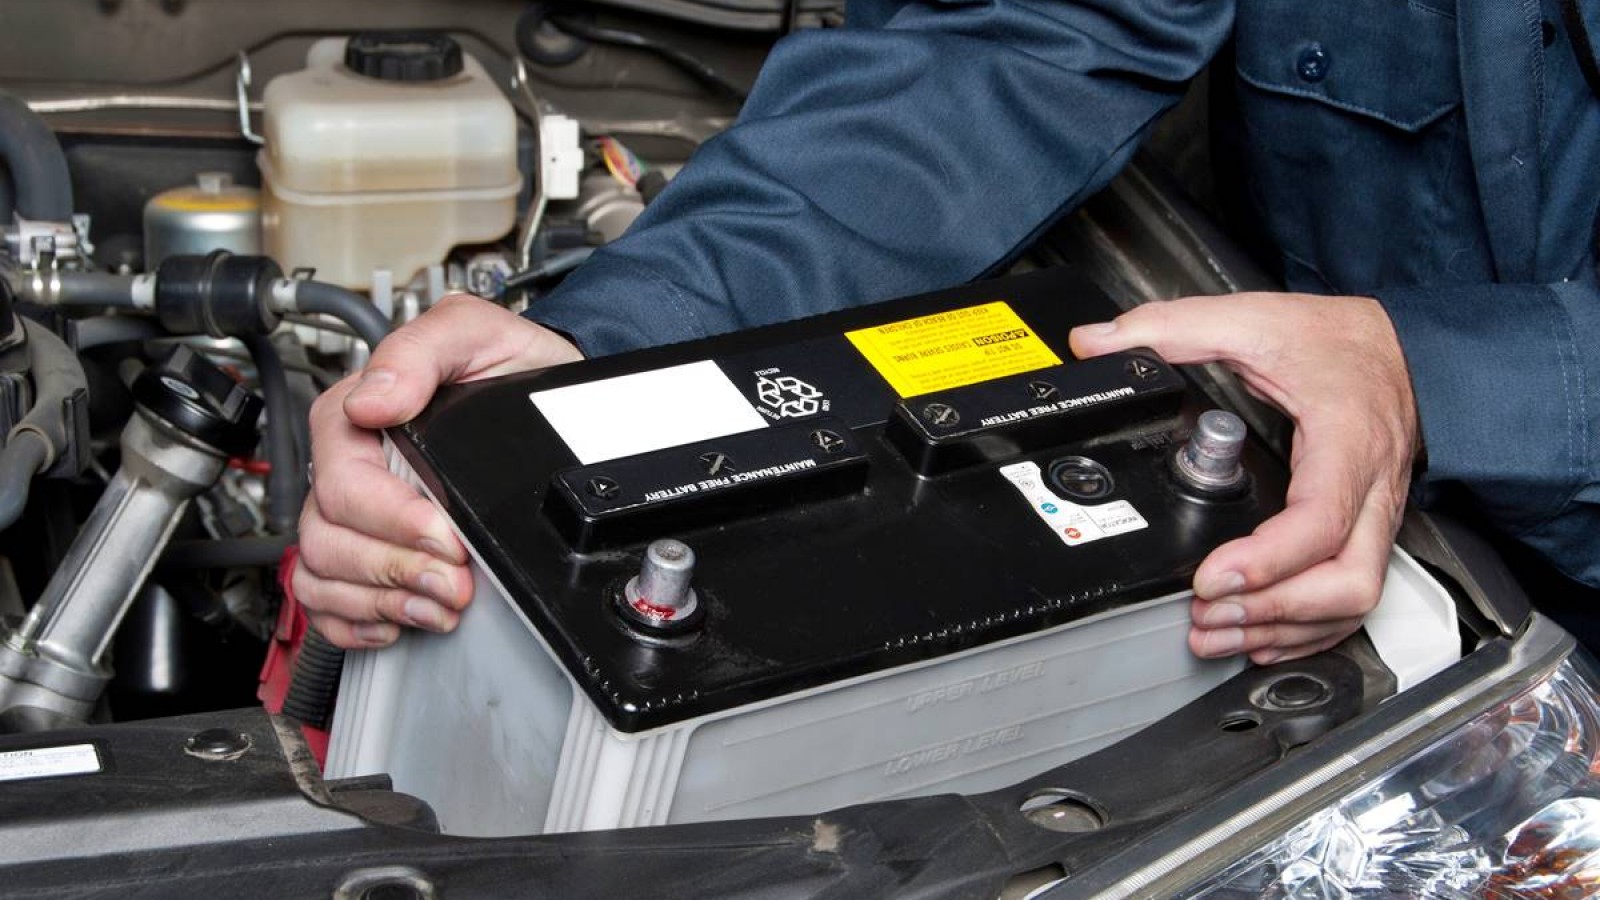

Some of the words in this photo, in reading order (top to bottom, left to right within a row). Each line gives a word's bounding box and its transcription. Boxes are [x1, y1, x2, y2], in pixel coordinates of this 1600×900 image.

[878, 321, 912, 334] CHILDREN
[975, 331, 1016, 346] POISON
[755, 367, 780, 376] RECYCLE
[1058, 388, 1135, 409] MAINTENANCE
[1030, 402, 1058, 416] FREE
[980, 410, 1029, 426] BATTERY
[731, 459, 816, 481] MAINTENANCE
[645, 482, 699, 502] BATTERY
[699, 476, 730, 492] FREE
[906, 682, 973, 713] UPPER
[980, 661, 1046, 694] LEVEL
[885, 744, 961, 776] LOWER
[962, 725, 1025, 754] LEVEL
